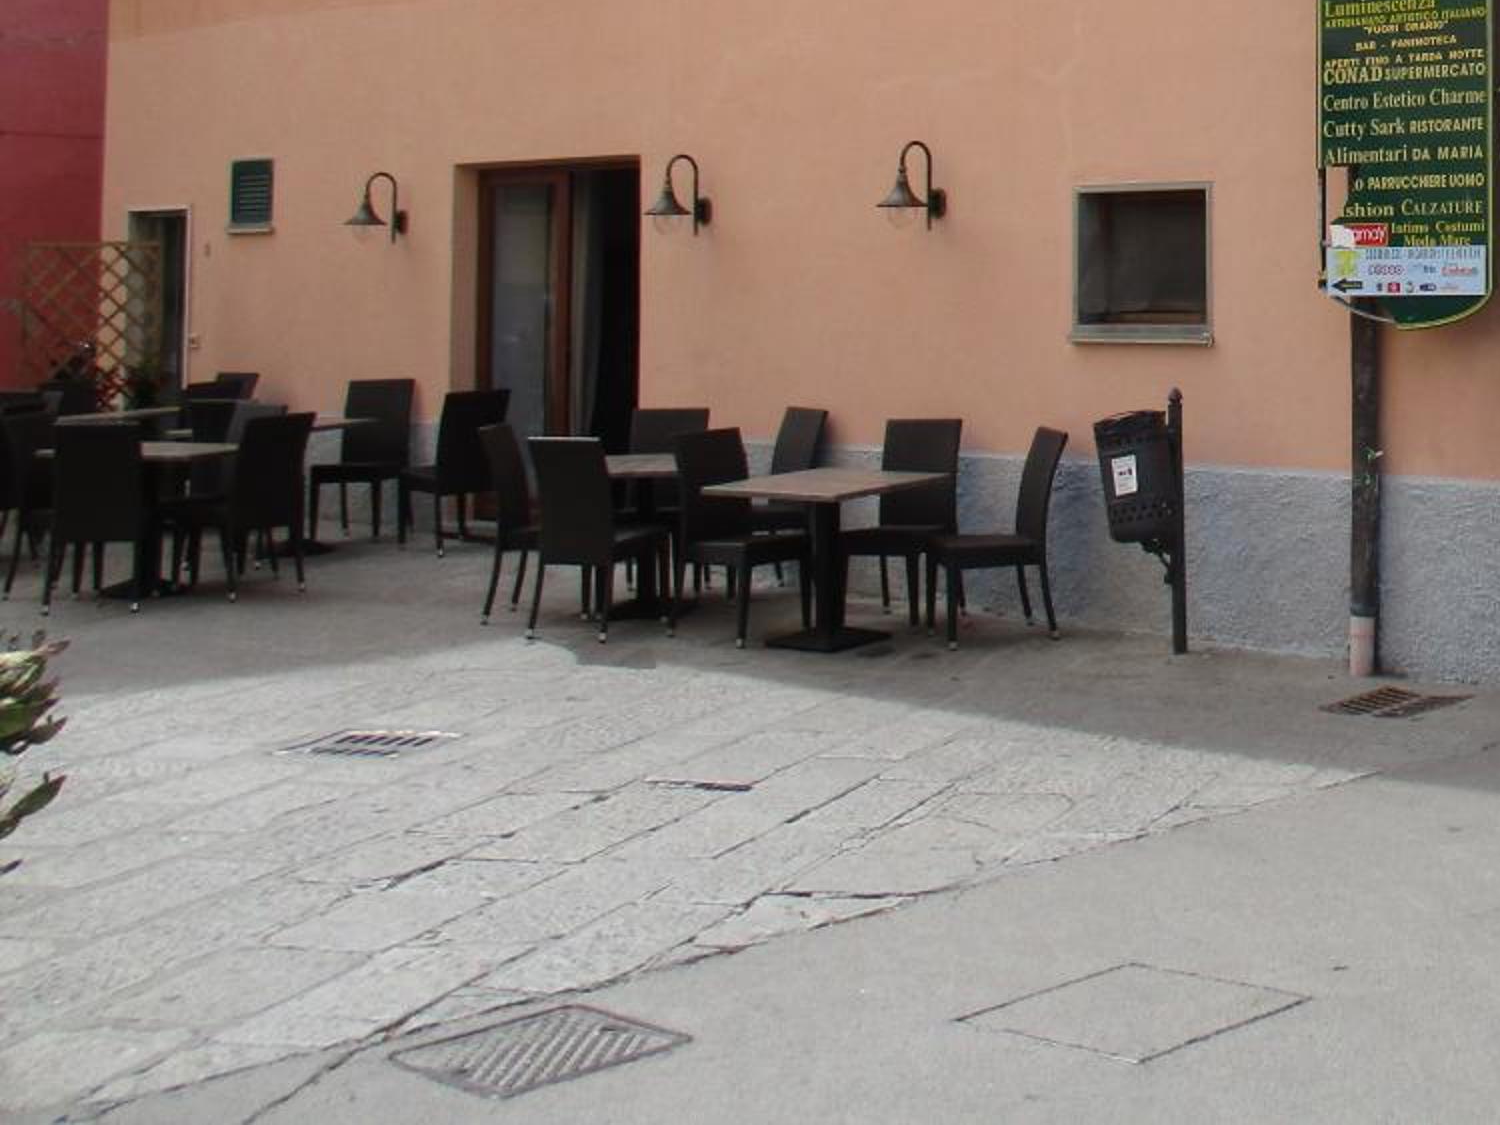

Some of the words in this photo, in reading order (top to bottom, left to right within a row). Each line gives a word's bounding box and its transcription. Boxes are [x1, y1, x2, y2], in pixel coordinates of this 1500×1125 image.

[1325, 15, 1387, 28] ARTIGIANATO
[1391, 11, 1439, 24] ARTISTICO
[1441, 6, 1485, 20] ITALIANO
[1355, 41, 1376, 52] BAR
[1391, 35, 1457, 48] PANINOTECA
[1365, 56, 1389, 66] FINO
[1396, 54, 1403, 64] A
[1408, 52, 1442, 63] TARDA
[1449, 48, 1485, 59] NOTTE
[1324, 66, 1383, 86] CONAD
[1385, 62, 1486, 81] SUPERMERCATO
[1324, 94, 1368, 112] Centro
[1373, 90, 1425, 110] Estetico
[1429, 88, 1487, 106] Charme
[1324, 120, 1364, 141] Cutty
[1370, 117, 1405, 136] Sark
[1409, 116, 1484, 134] RISTORANTE
[1325, 144, 1408, 164] Alimentari
[1412, 148, 1431, 161] DA
[1437, 144, 1484, 160] MARIA
[1368, 174, 1447, 190] PARRUCCHIERE
[1450, 173, 1485, 188] UOMO
